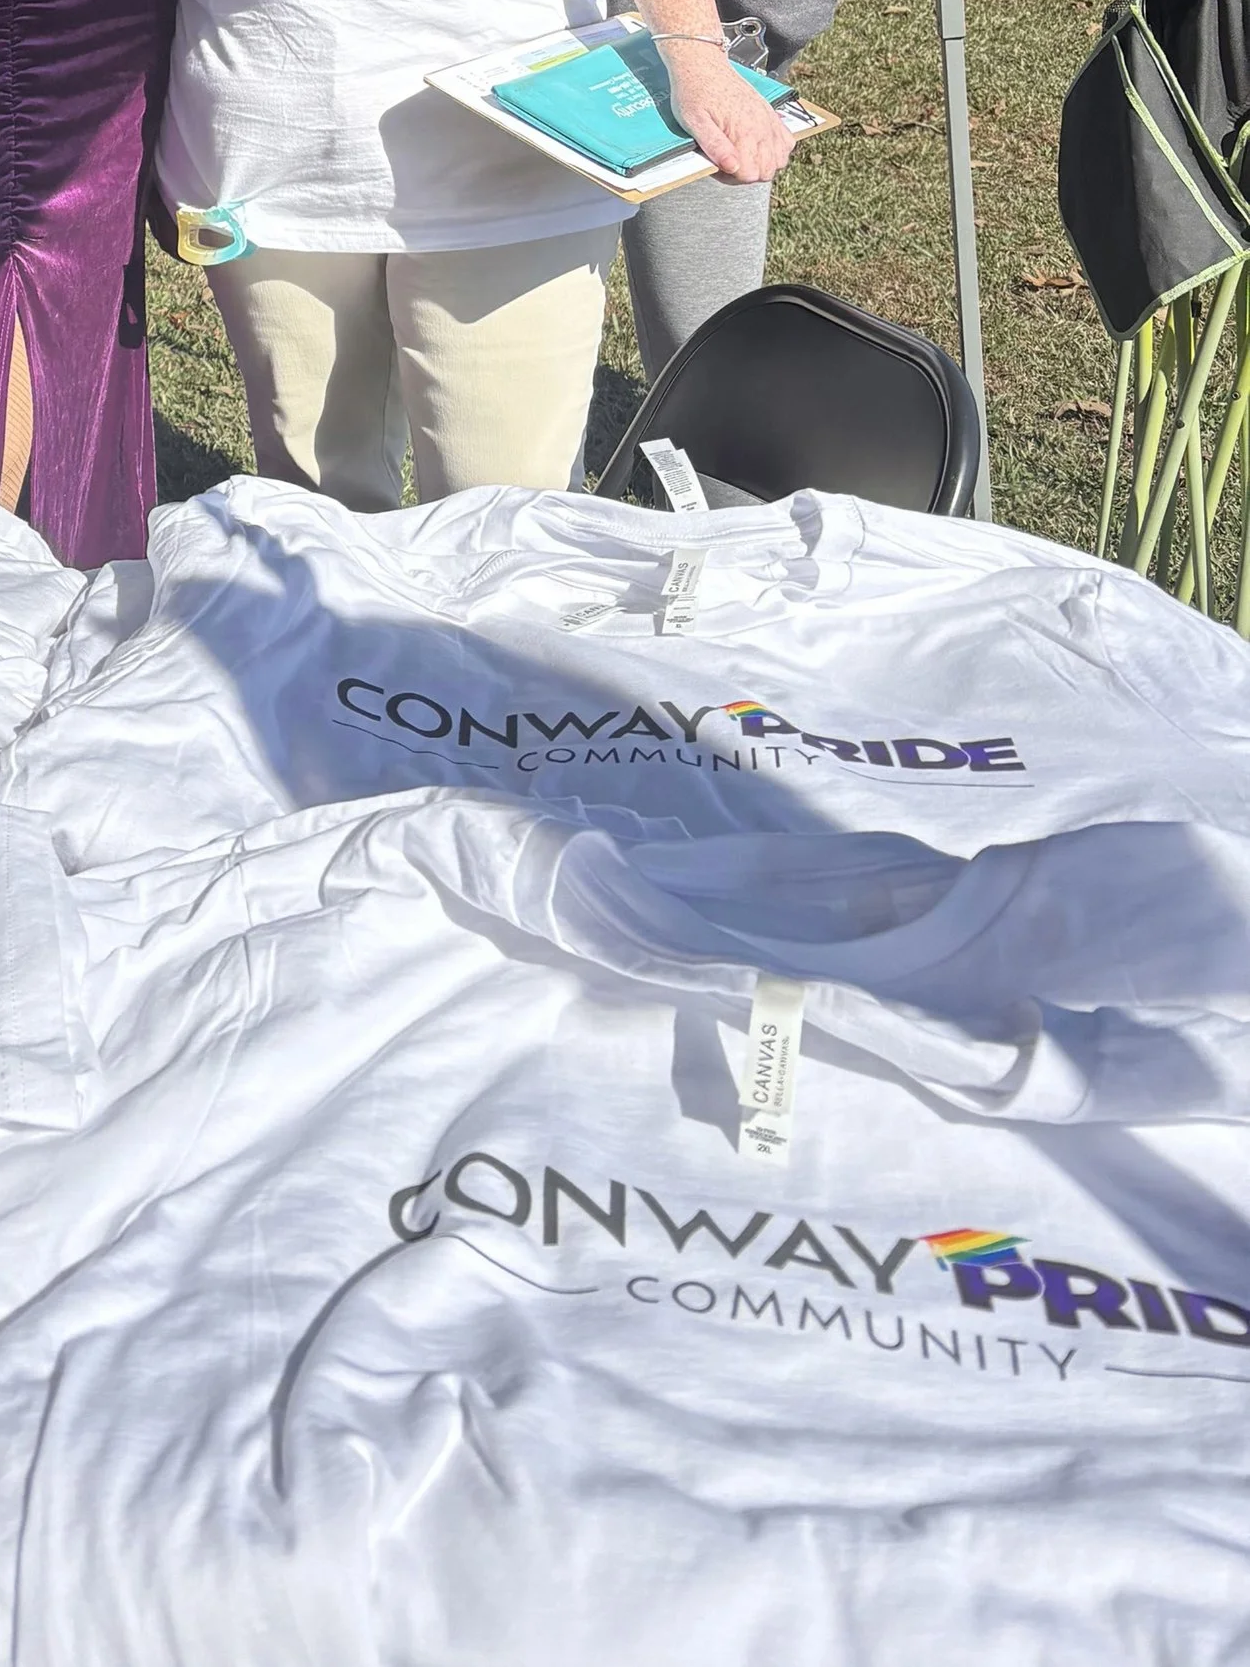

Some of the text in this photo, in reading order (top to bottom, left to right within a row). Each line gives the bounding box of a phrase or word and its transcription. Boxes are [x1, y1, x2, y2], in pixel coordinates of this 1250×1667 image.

[668, 562, 689, 593] CANVAS
[335, 676, 1028, 772] CONWAY PRIDE
[515, 742, 825, 772] COMMUNITY
[752, 1023, 779, 1104] CANVAS
[388, 1151, 920, 1295] CONWAY
[626, 1274, 1080, 1383] COMMUNITY
